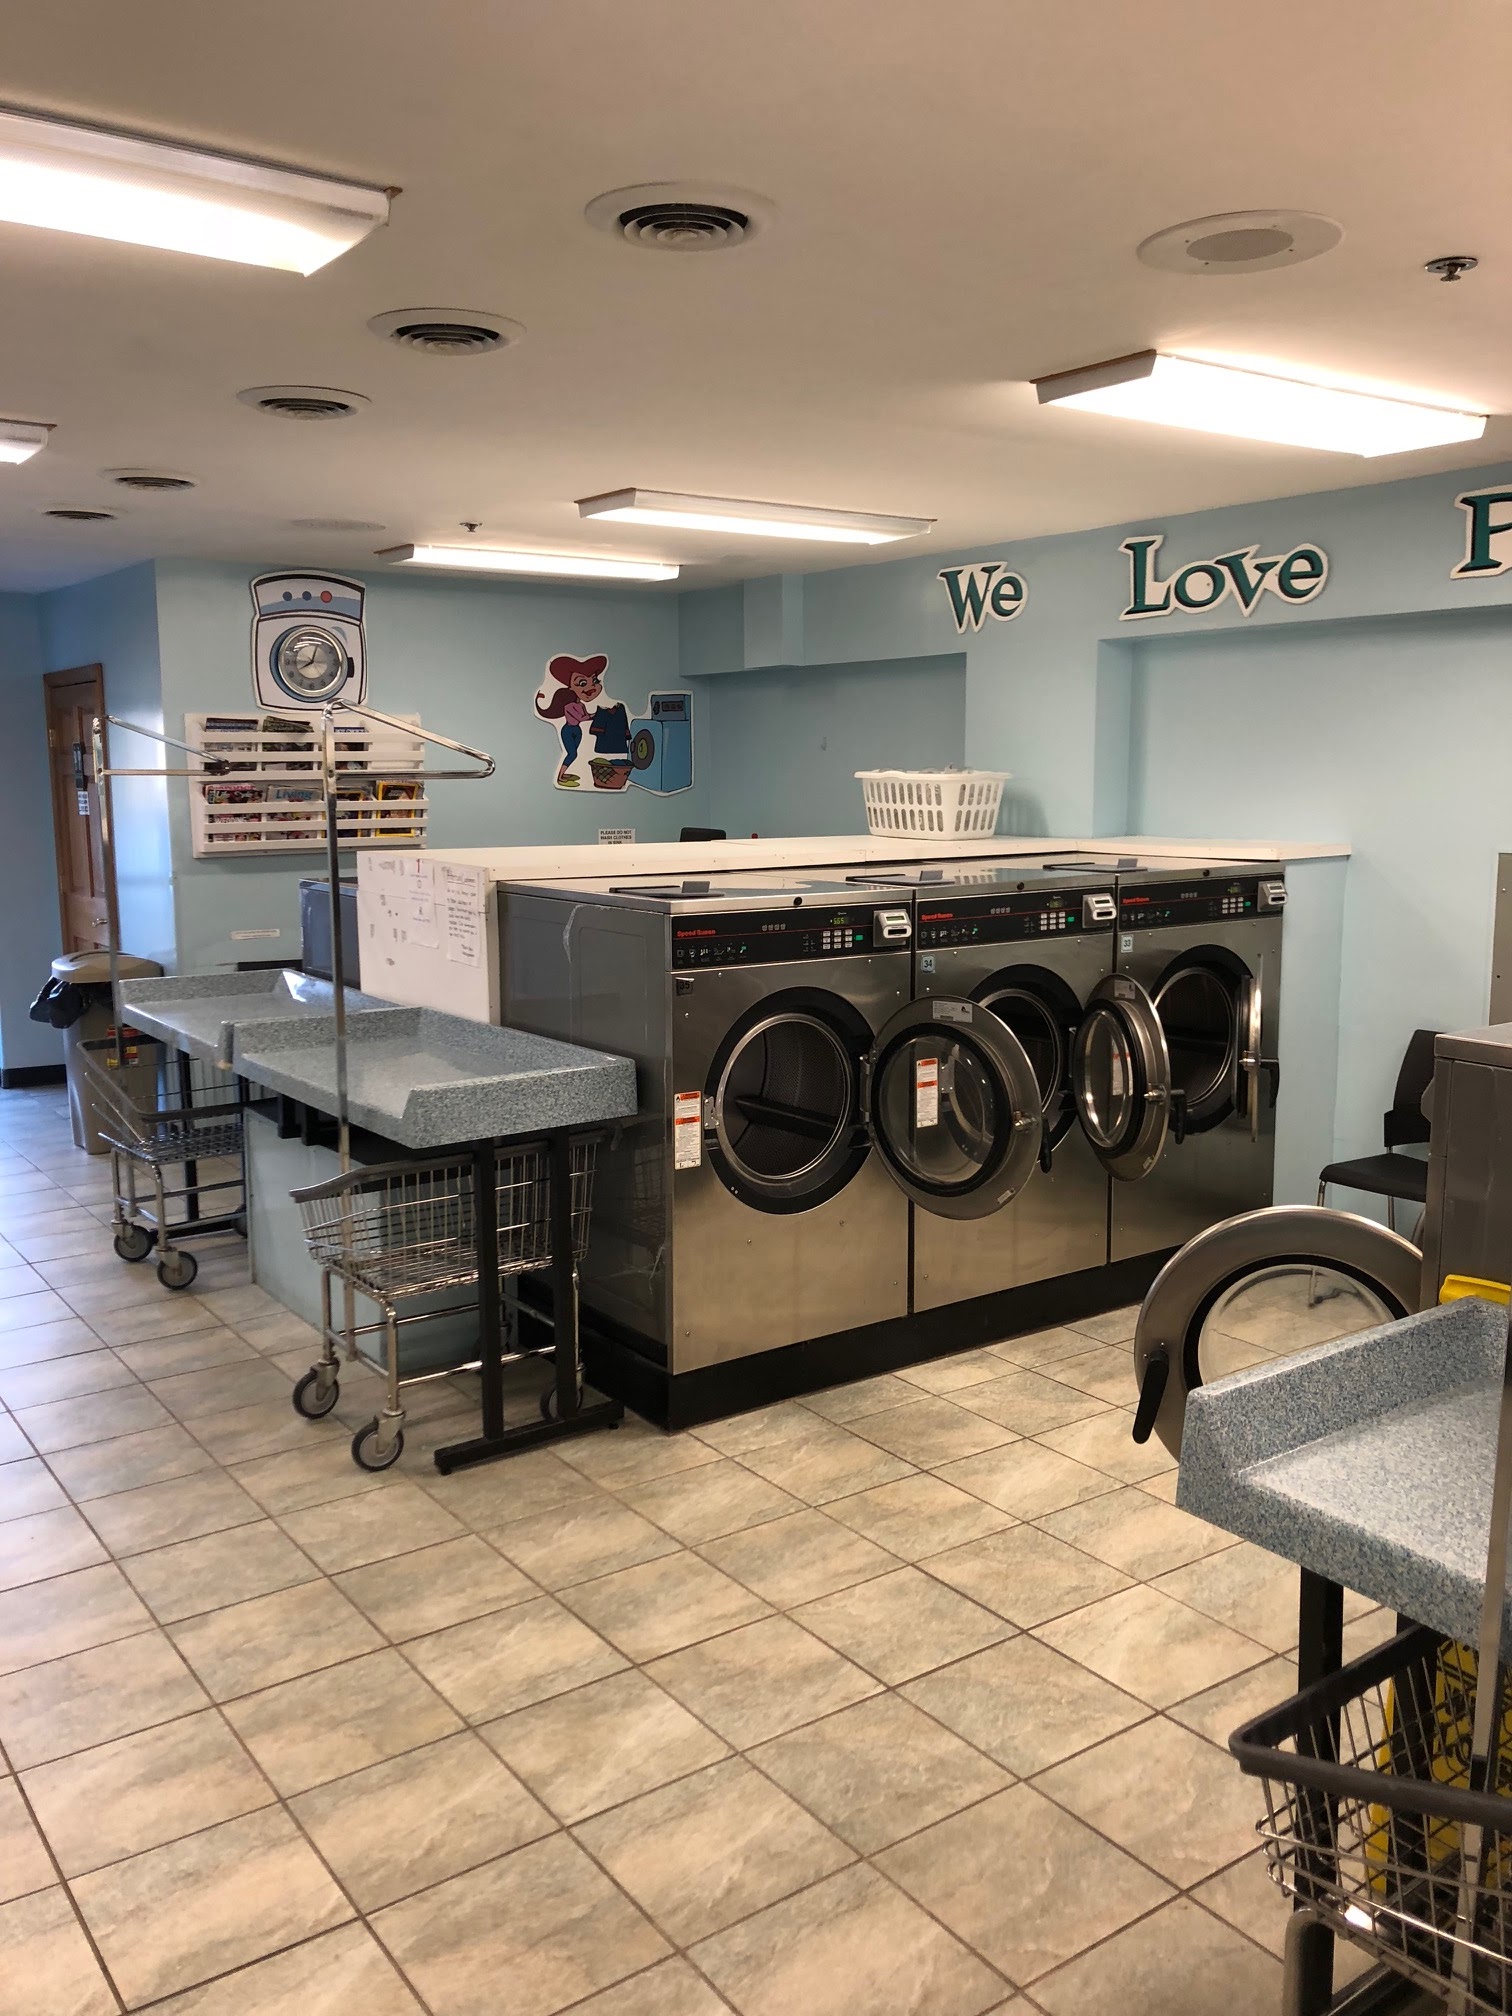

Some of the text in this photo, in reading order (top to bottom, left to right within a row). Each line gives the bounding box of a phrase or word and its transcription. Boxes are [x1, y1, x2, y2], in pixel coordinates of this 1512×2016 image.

[938, 563, 1025, 631] We
[1122, 538, 1325, 618] Love
[275, 789, 313, 801] Living
[924, 960, 932, 968] 34
[680, 981, 690, 990] 35
